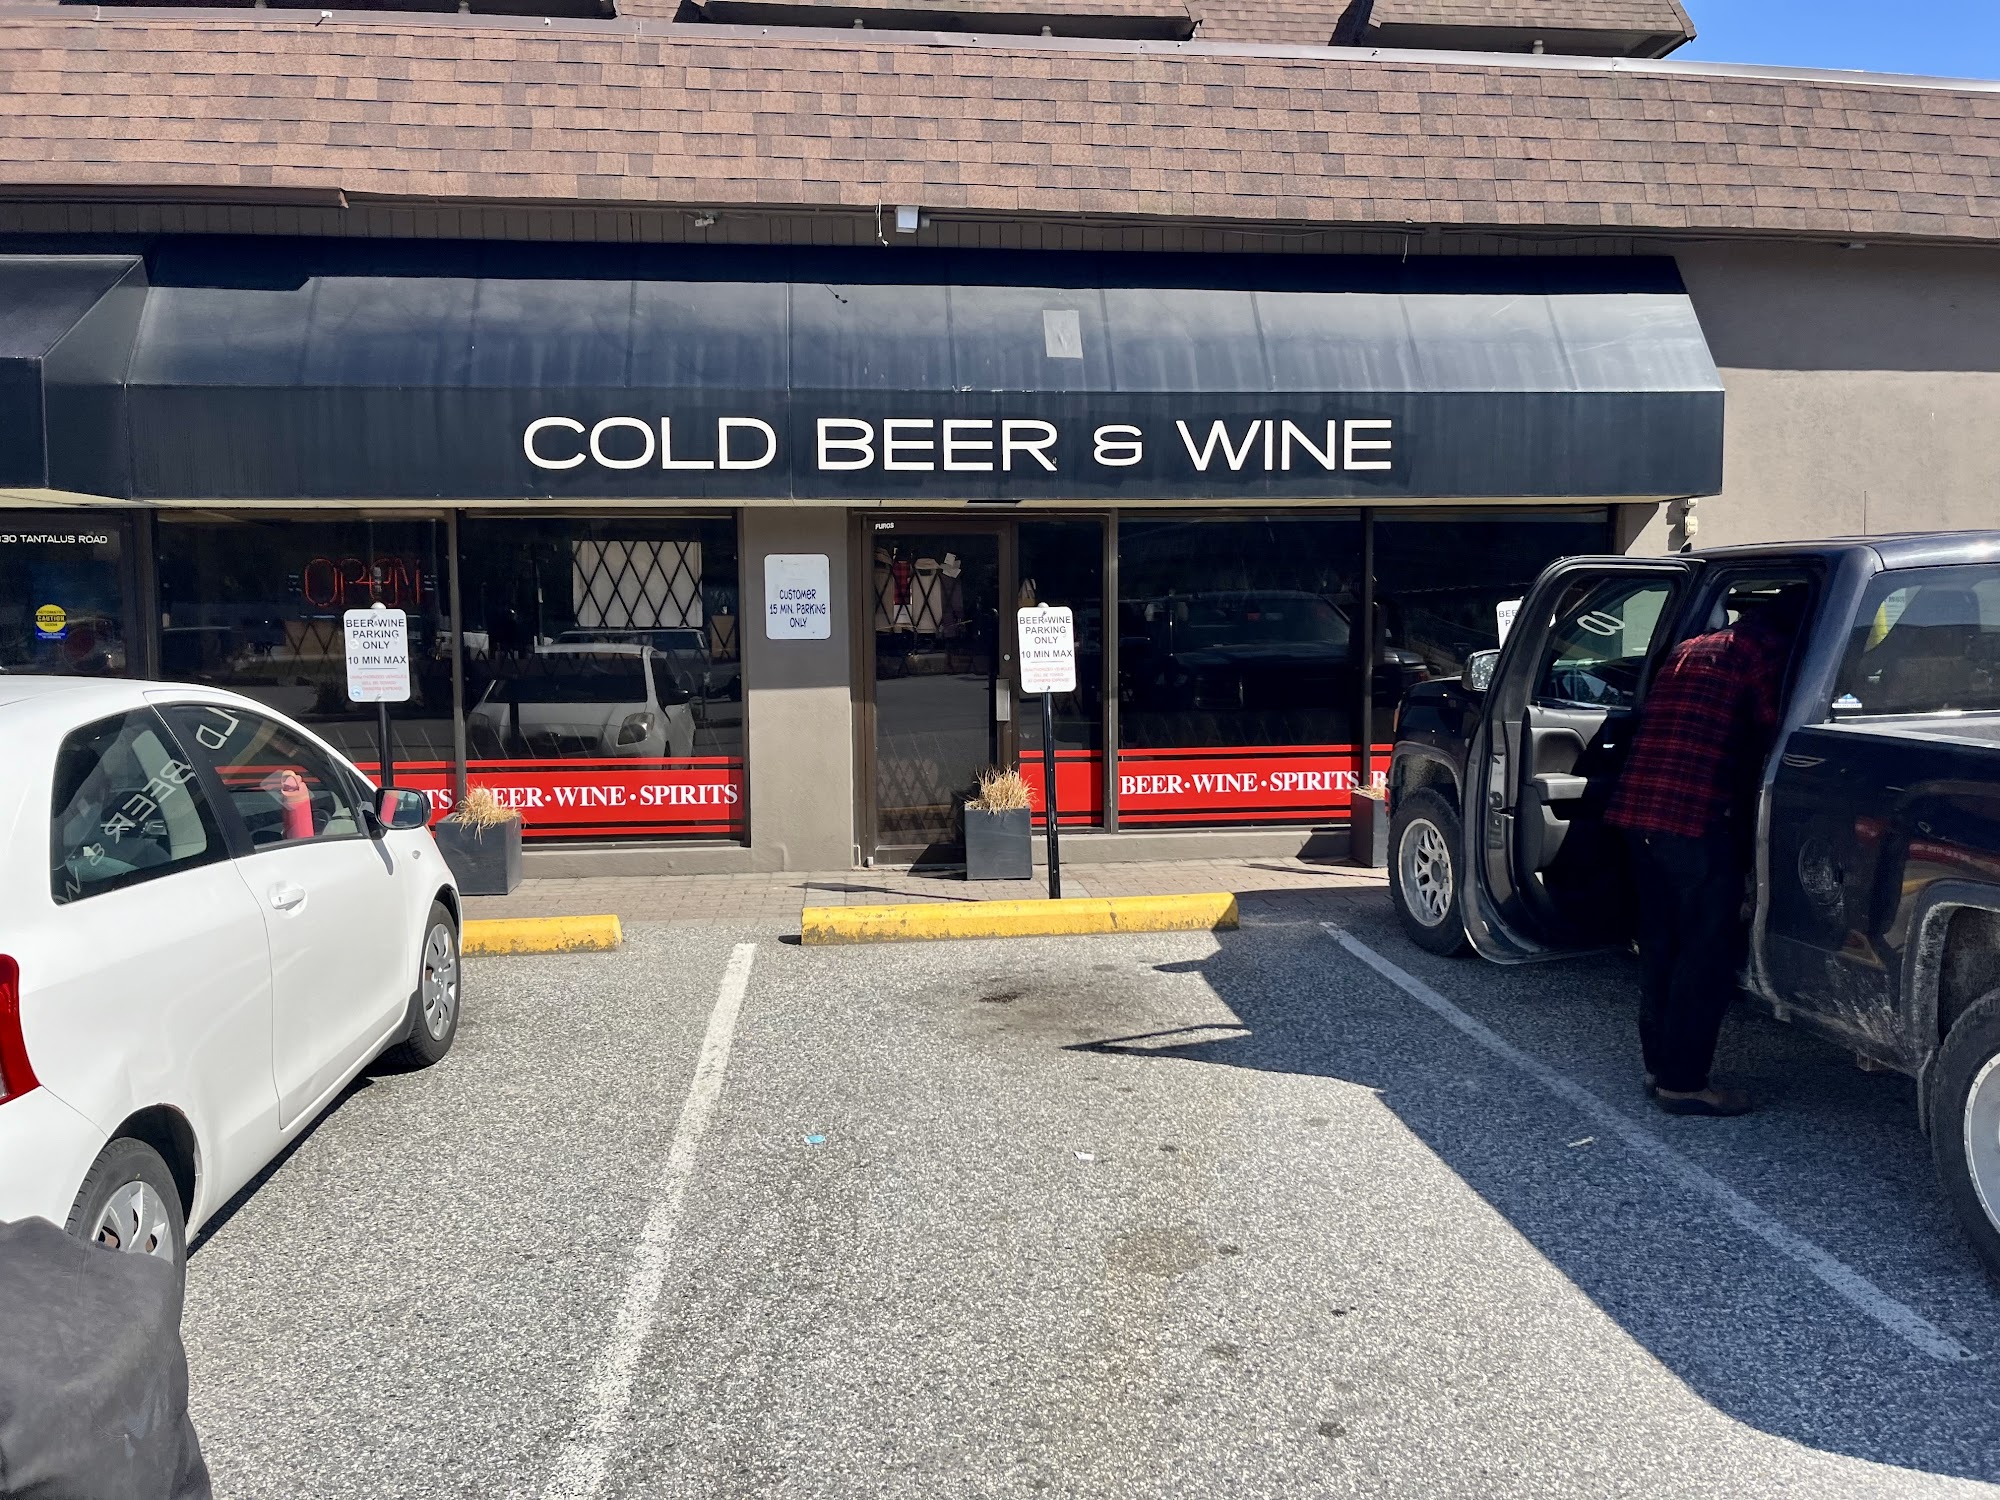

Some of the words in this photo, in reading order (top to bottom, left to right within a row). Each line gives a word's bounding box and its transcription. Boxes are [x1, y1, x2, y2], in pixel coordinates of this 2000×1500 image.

[523, 416, 777, 470] COLD
[816, 417, 1058, 472] BEER
[1093, 424, 1143, 466] &
[1175, 419, 1392, 471] WINE
[0, 534, 17, 544] 30
[19, 534, 76, 544] TANTALUS
[78, 535, 108, 544] ROAD
[304, 558, 421, 607] OPEN
[769, 603, 778, 614] 15
[789, 617, 807, 628] ONLY
[352, 630, 400, 639] PARKING
[362, 641, 390, 650] ONLY
[1034, 636, 1058, 645] ONLY
[348, 656, 359, 665] 10
[362, 656, 381, 665] MIN
[383, 655, 407, 664] MAX
[1120, 775, 1184, 795] BEER
[1191, 773, 1258, 793] WINE
[1269, 771, 1359, 791] SPIRITS
[552, 786, 627, 807] WINE
[639, 783, 738, 806] SPIRITS
